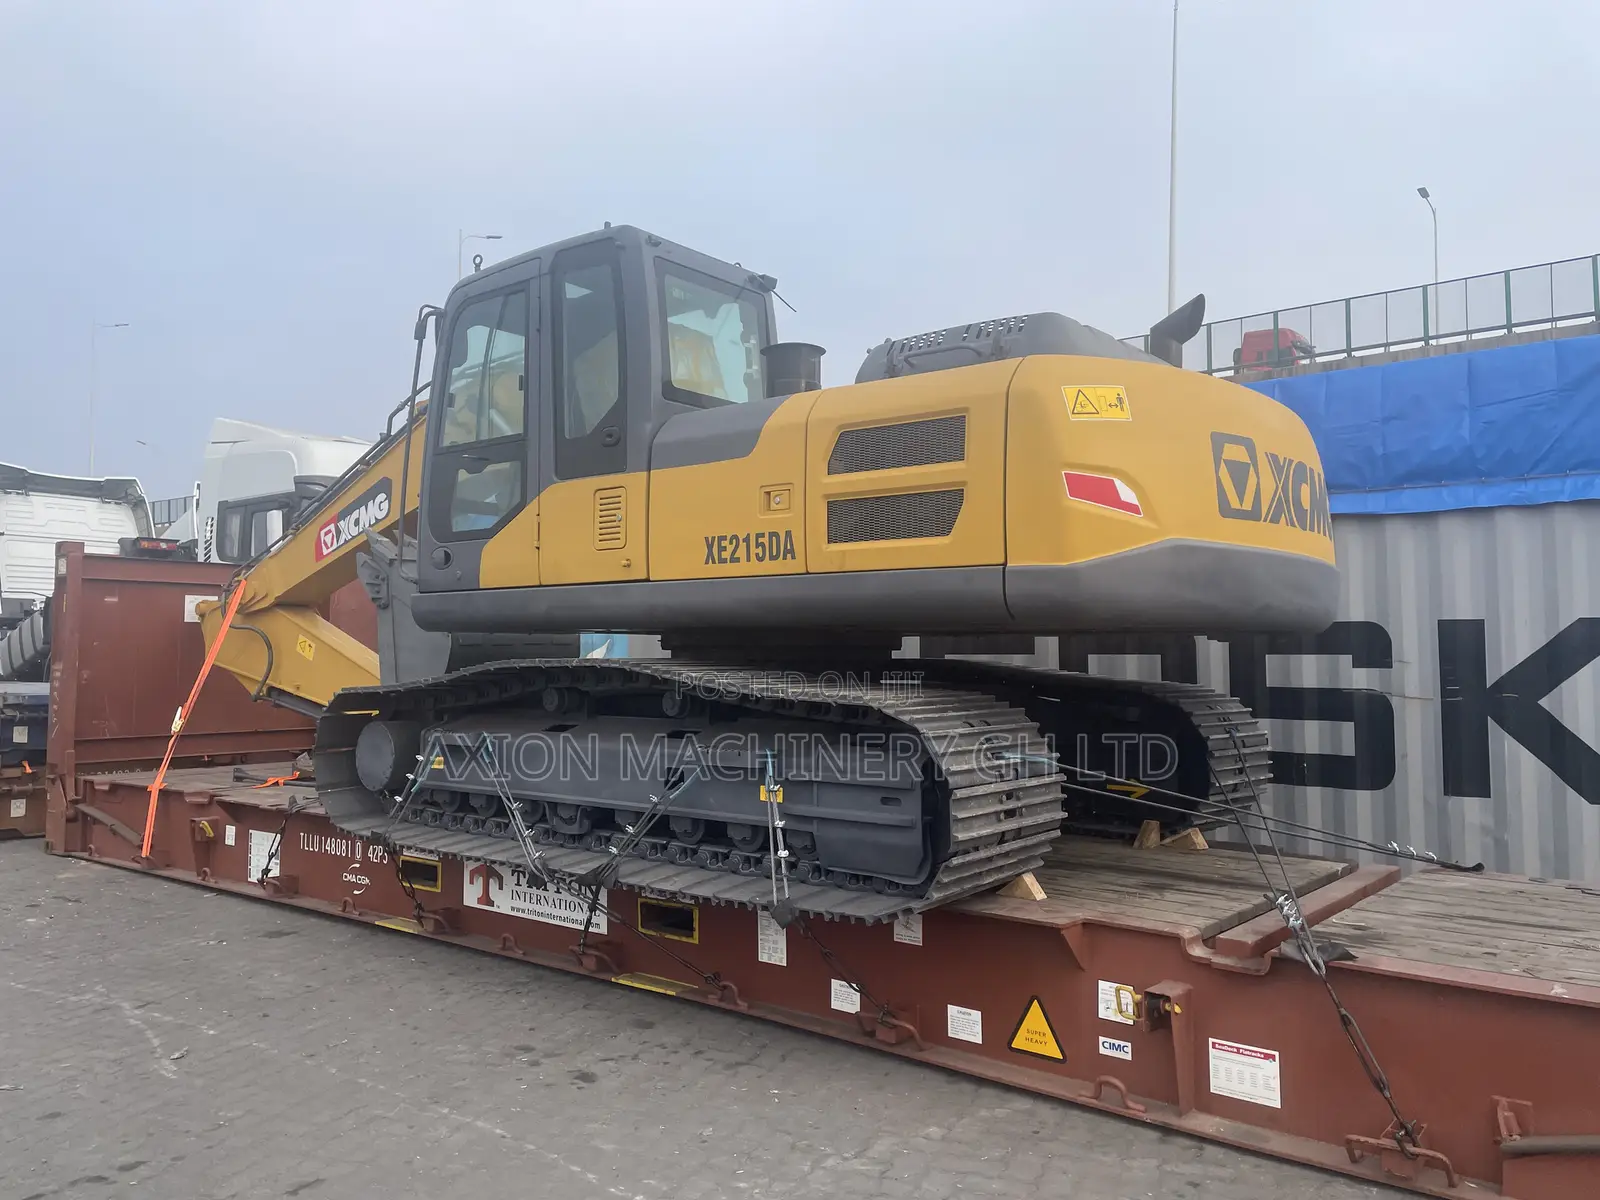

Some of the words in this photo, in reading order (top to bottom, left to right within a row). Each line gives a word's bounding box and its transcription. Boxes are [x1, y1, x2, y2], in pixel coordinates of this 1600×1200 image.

[1262, 452, 1333, 542] XCM
[337, 492, 389, 547] XCMG
[704, 529, 797, 565] XE215DA
[1025, 1036, 1048, 1047] HEAVY
[1026, 1028, 1047, 1038] SUPER
[1101, 1040, 1129, 1054] CIMC
